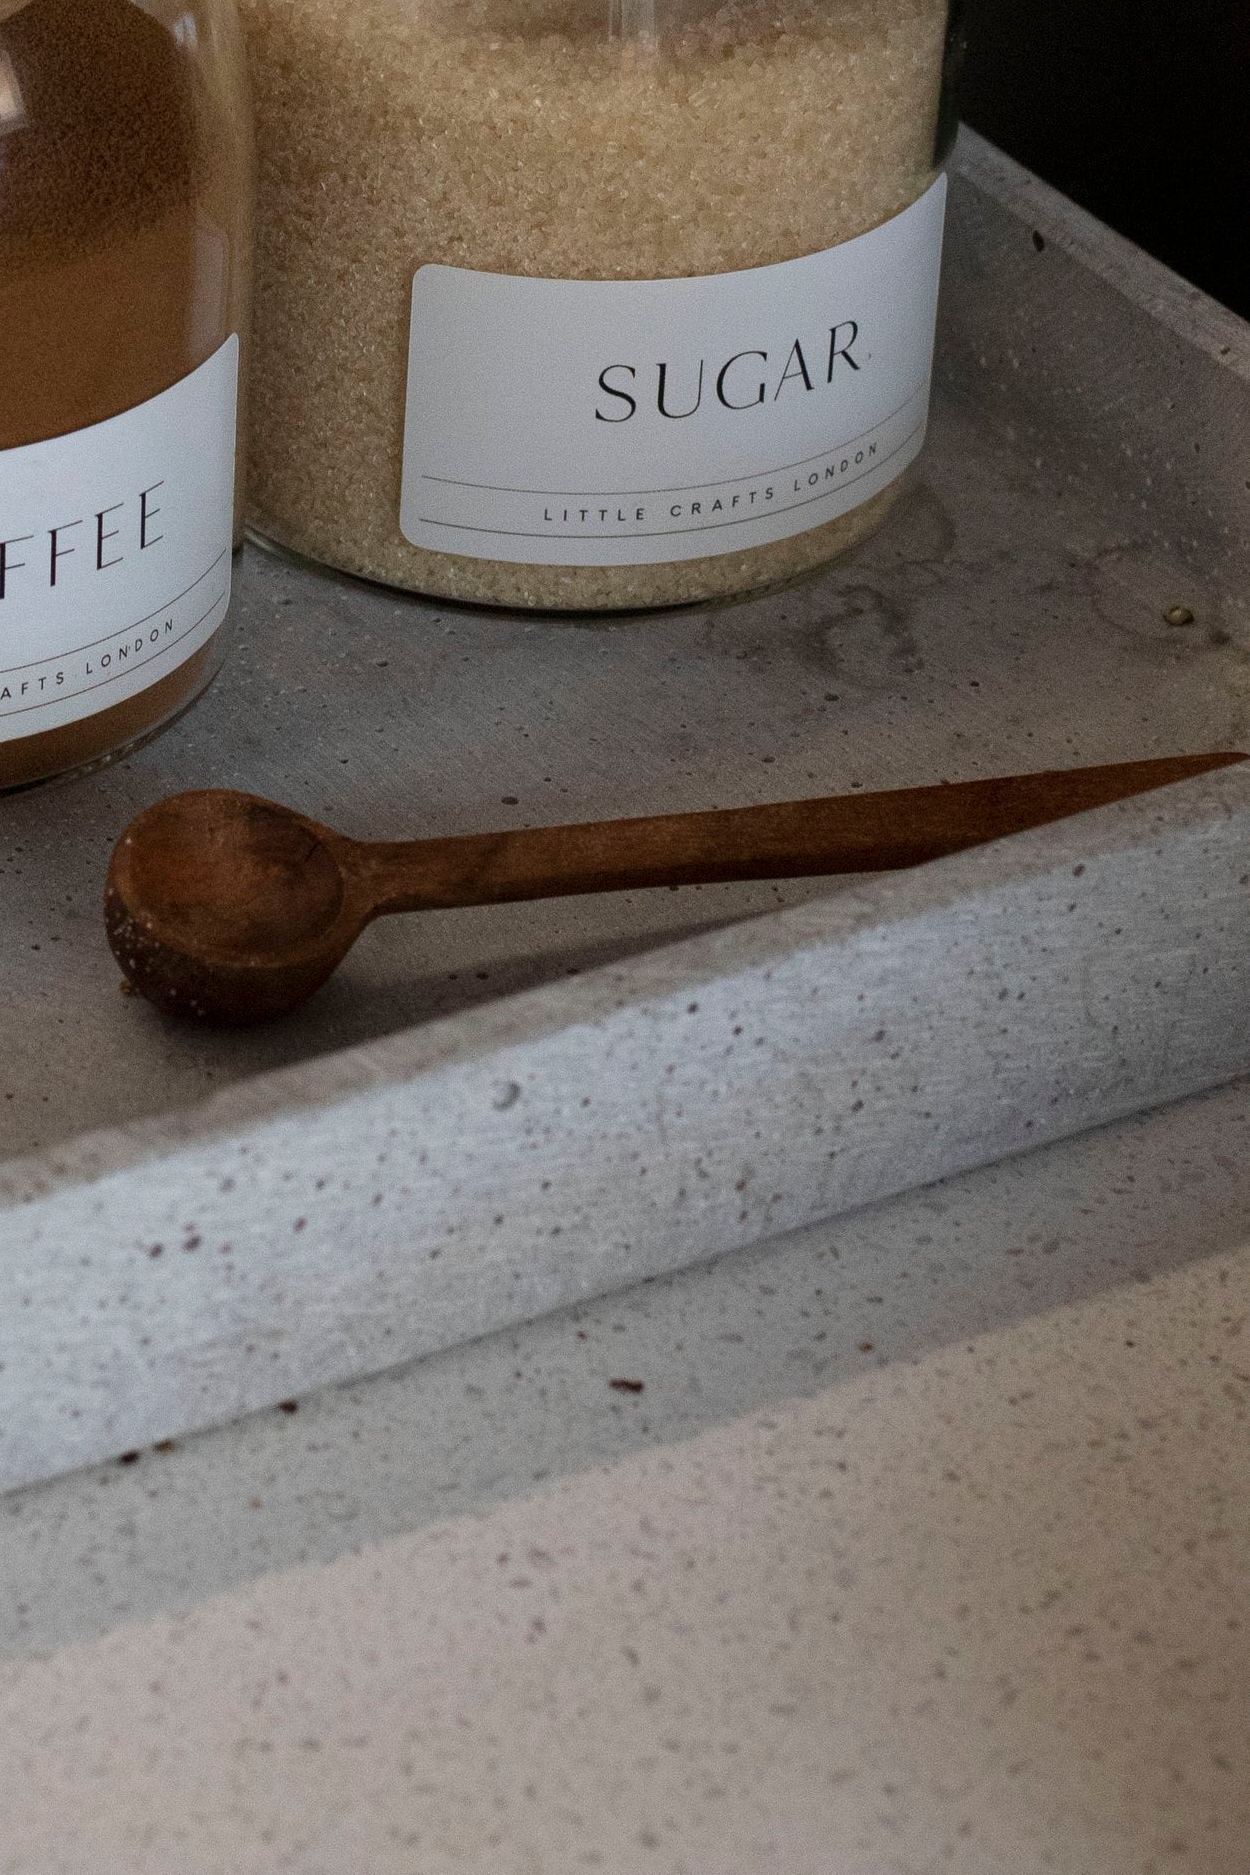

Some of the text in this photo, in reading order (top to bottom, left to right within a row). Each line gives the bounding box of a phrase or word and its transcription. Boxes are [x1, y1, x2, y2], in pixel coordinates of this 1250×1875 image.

[594, 319, 863, 424] SUGAR
[543, 441, 878, 523] LITTLE CRAFTS LONDON
[85, 618, 175, 676] LONDON
